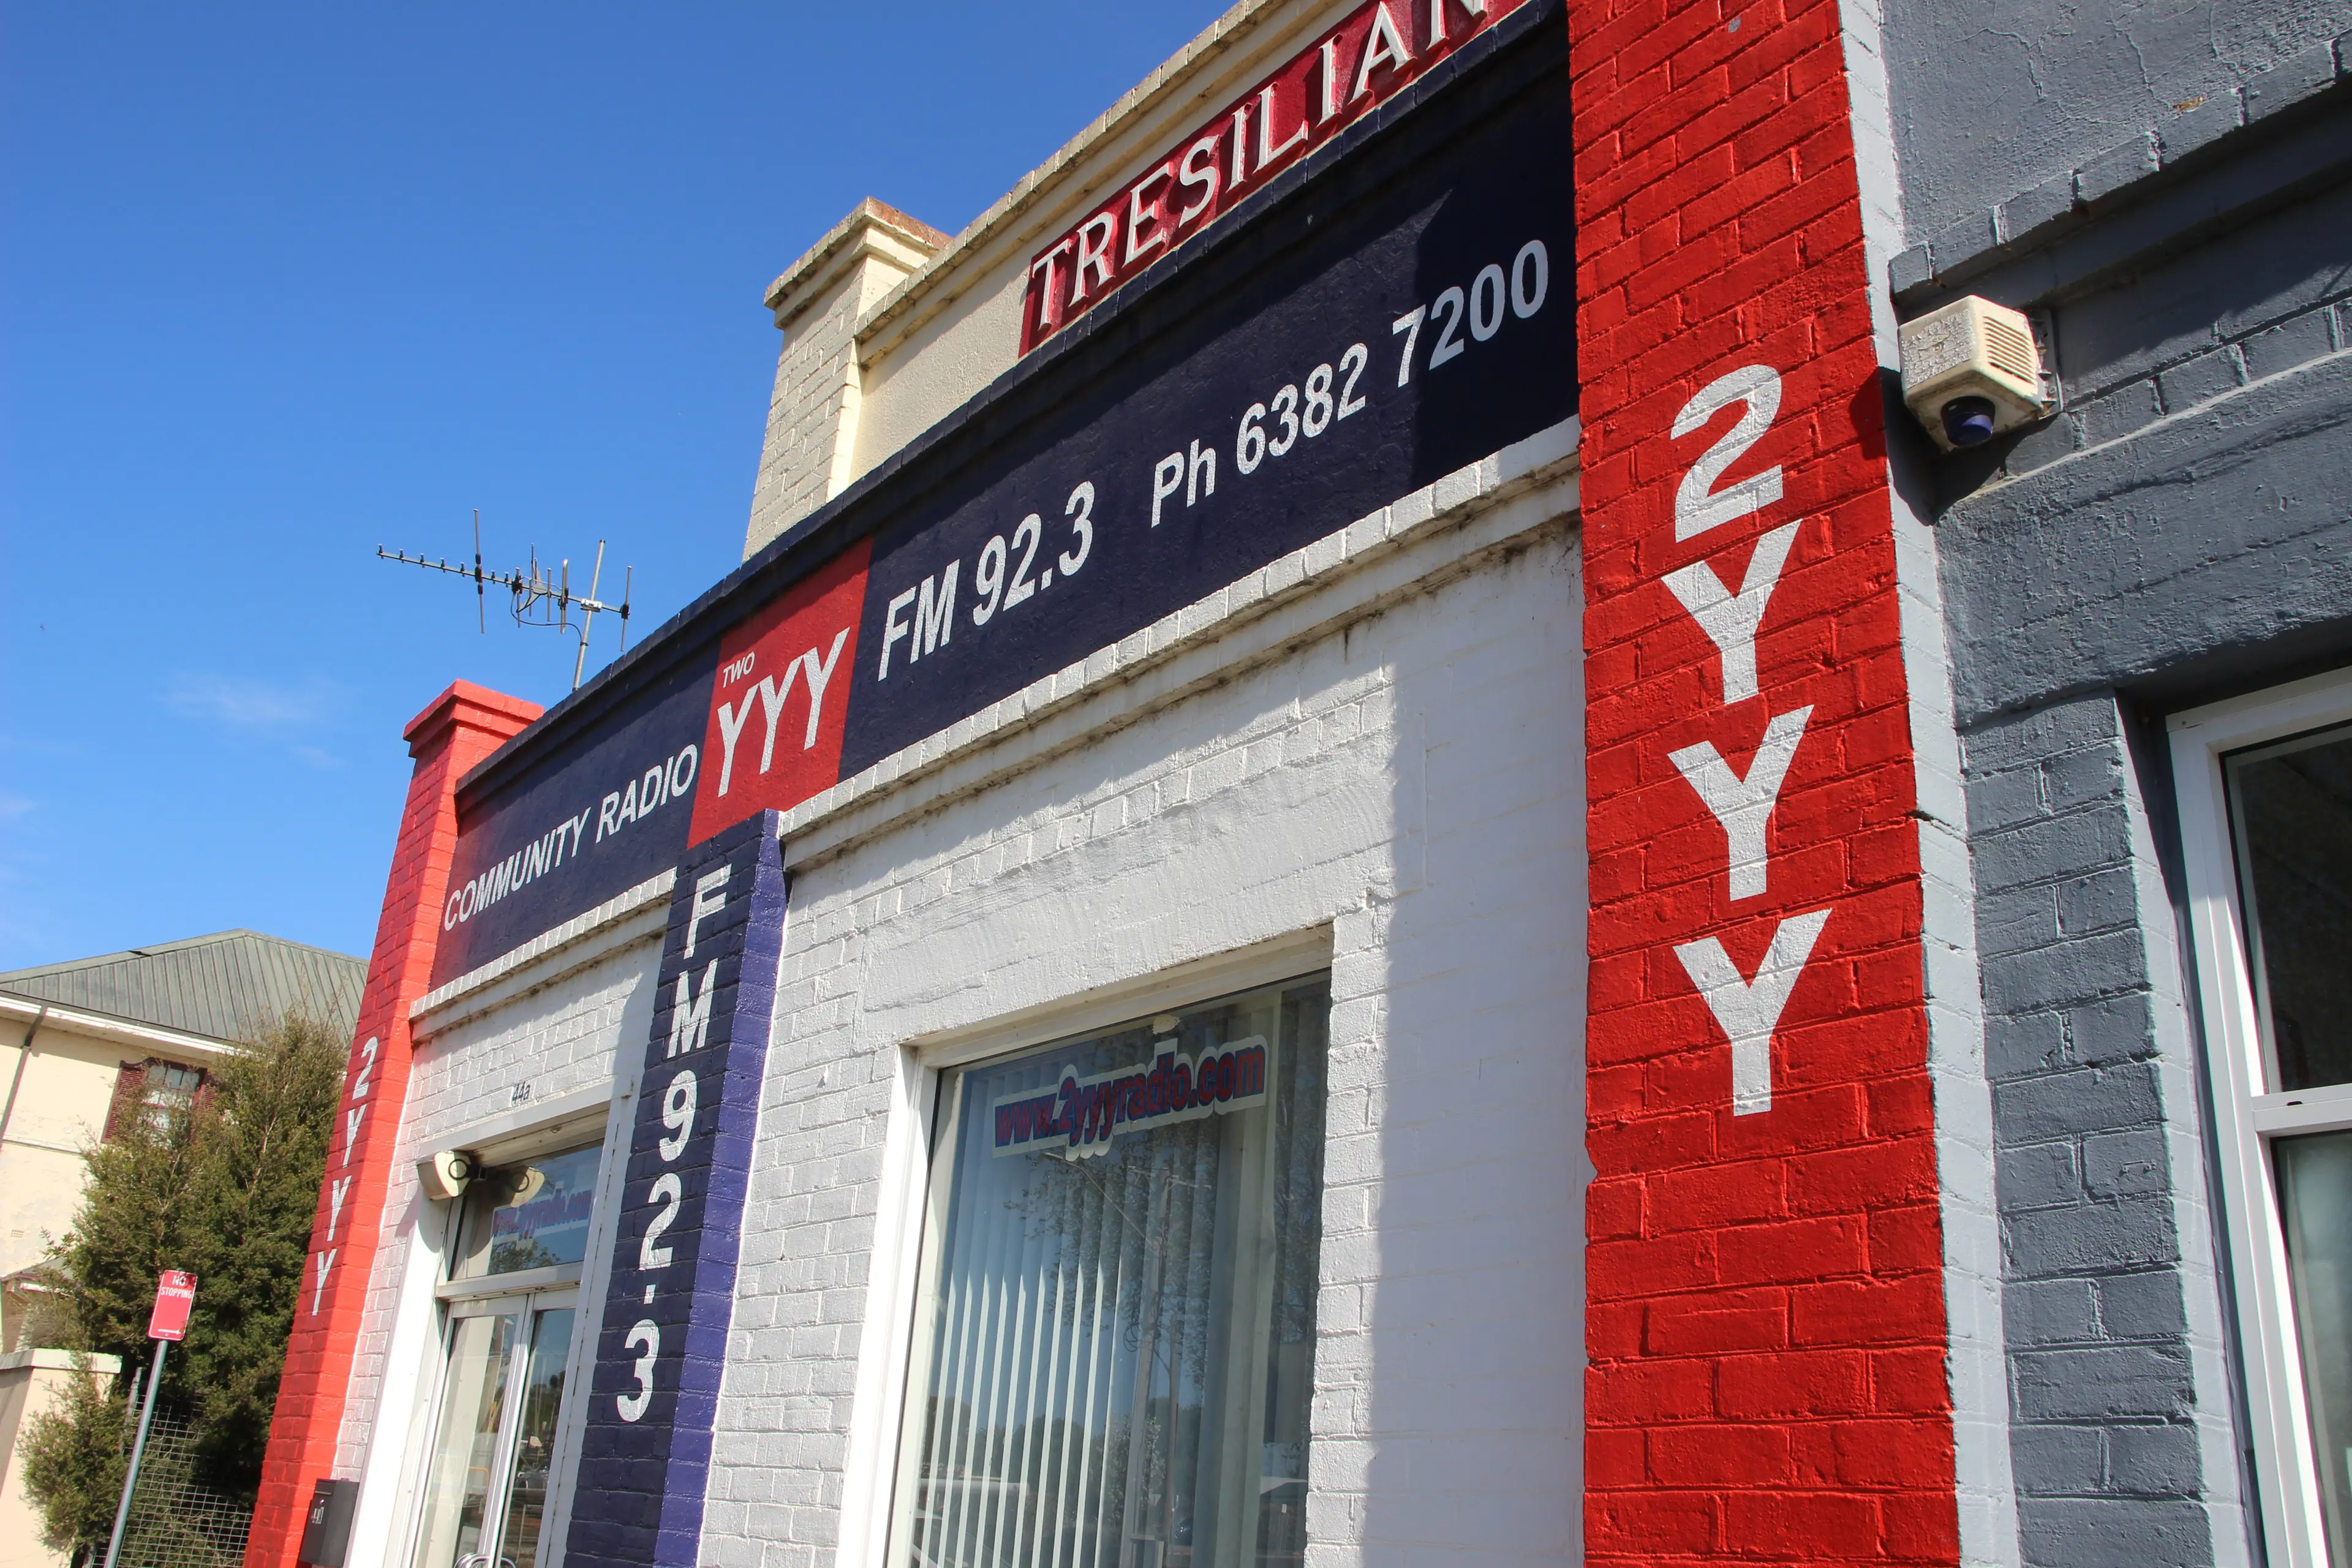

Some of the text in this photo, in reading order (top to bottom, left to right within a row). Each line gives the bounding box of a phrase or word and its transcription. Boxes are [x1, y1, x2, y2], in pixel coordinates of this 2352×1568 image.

[878, 239, 1549, 682] FM 92.3 Ph 6382 7200
[717, 626, 850, 798] YYY
[722, 652, 755, 688] TWO
[1660, 364, 1833, 1117] 2YYY
[444, 744, 698, 932] COMMUNITY RADIO
[512, 1080, 530, 1104] 44a
[995, 1050, 1266, 1148] www.2yyyradio.com
[312, 1036, 378, 1316] 2YYY
[160, 1286, 194, 1299] STOPPING
[172, 1275, 187, 1287] NO
